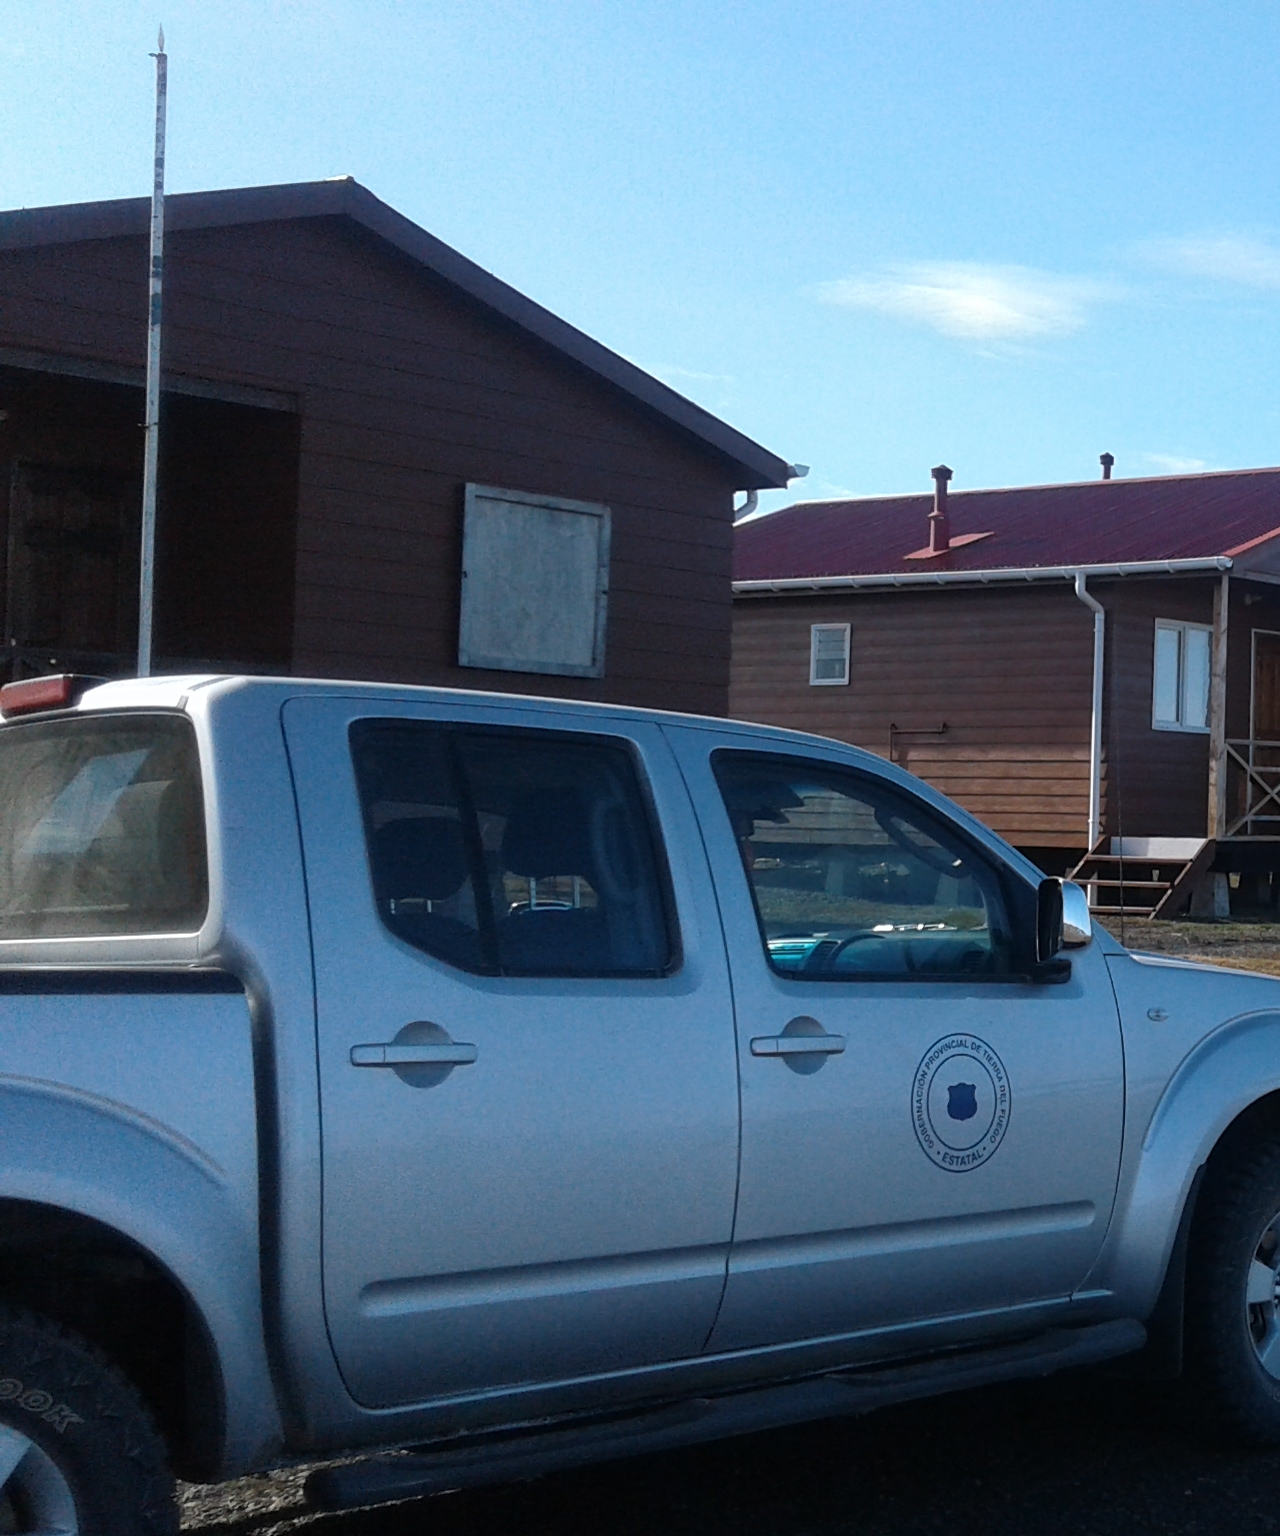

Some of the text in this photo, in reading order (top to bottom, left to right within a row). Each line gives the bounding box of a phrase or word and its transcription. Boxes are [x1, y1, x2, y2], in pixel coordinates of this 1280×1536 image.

[916, 1039, 1007, 1149] GOBERNACIÓN PROVINCIAL DE TIERRA DEL FUEGO
[942, 1149, 984, 1167] ESTATAL
